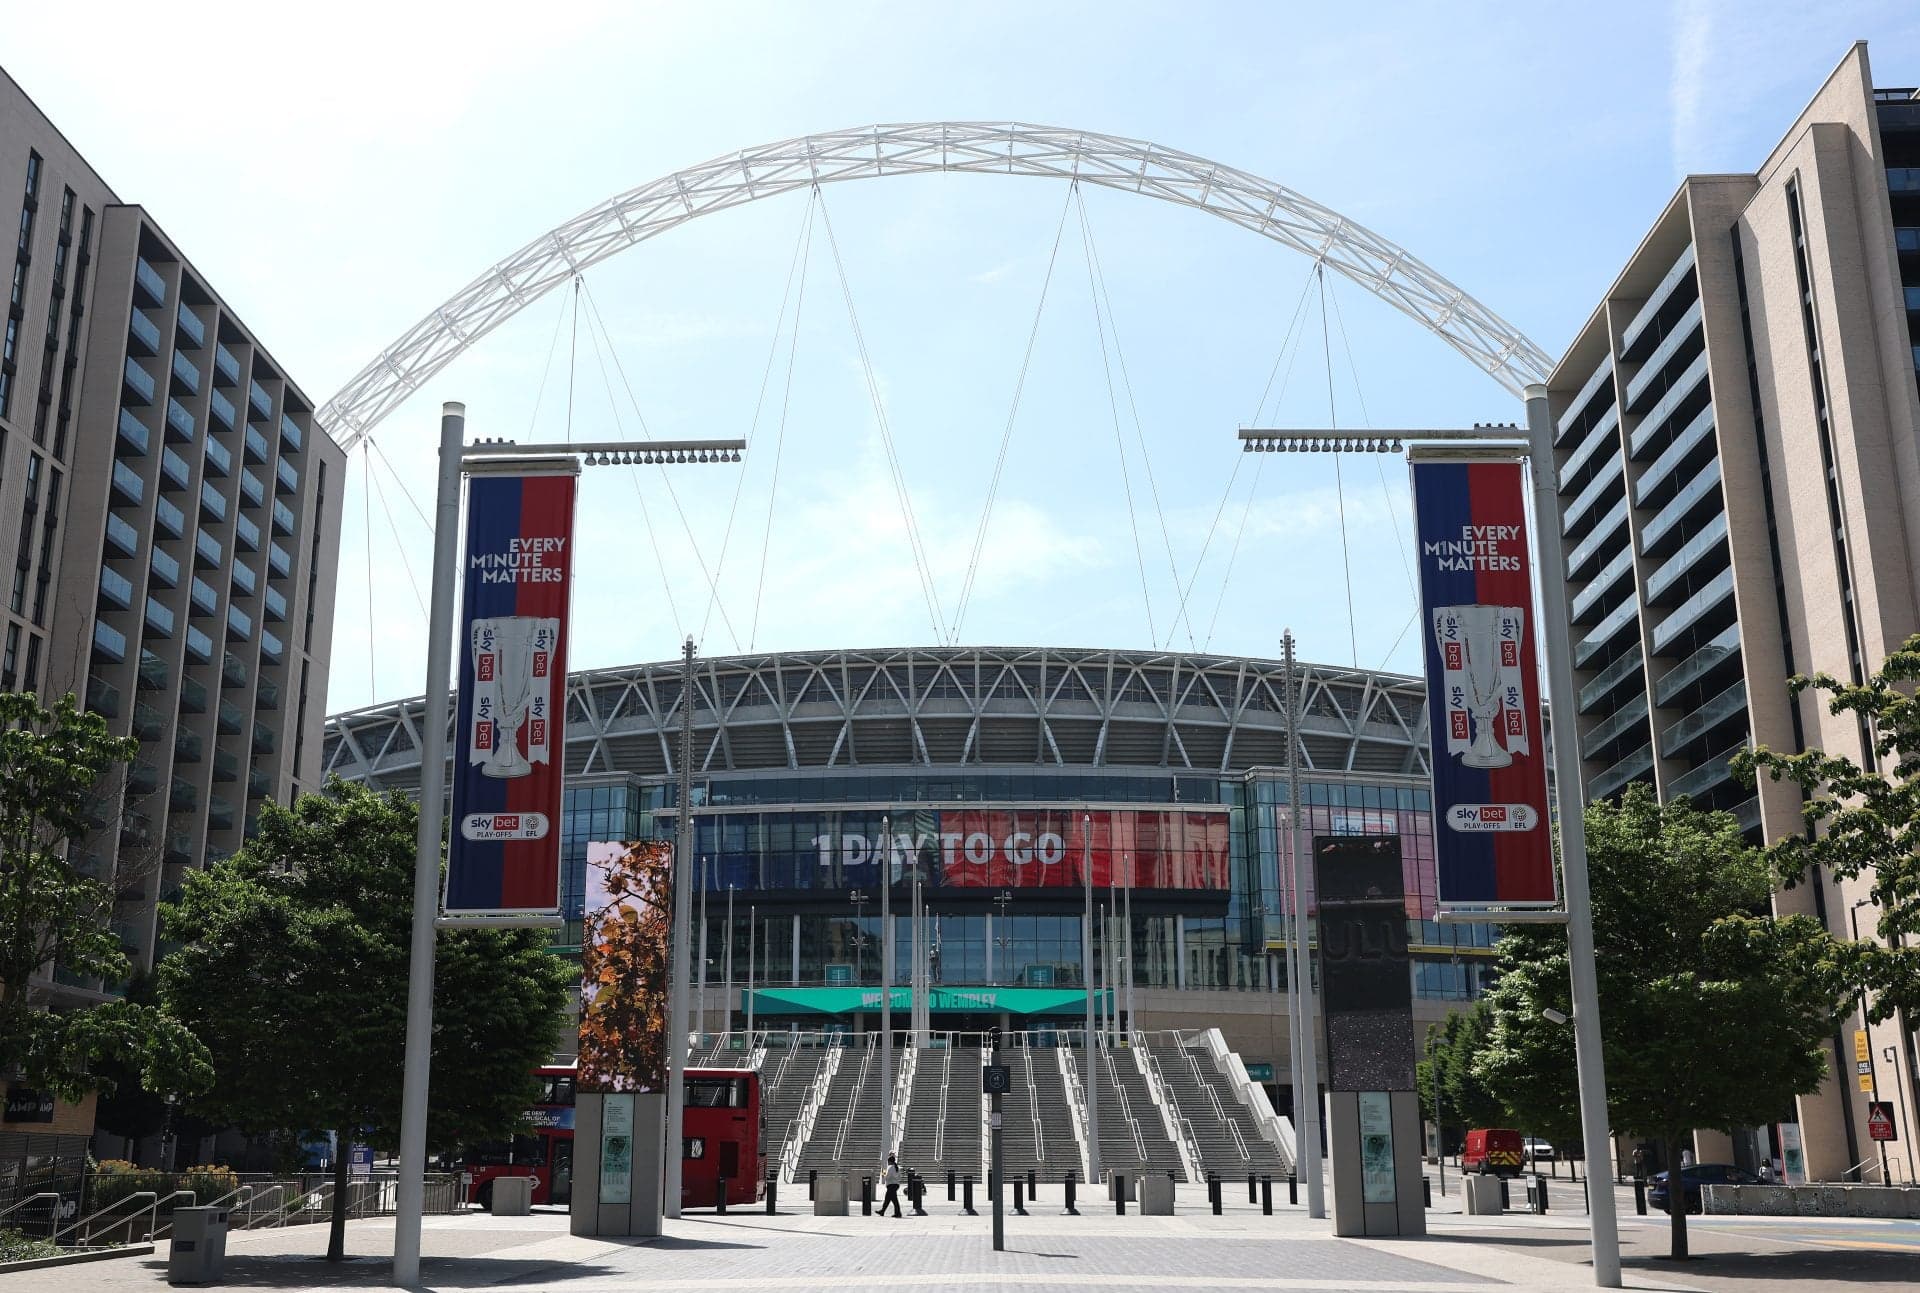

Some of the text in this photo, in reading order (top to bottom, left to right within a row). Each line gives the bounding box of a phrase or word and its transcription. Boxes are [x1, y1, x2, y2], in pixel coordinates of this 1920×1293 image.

[509, 537, 566, 553] EVERY
[1463, 526, 1520, 540] EVERY
[482, 568, 563, 583] MATTERS
[1438, 556, 1520, 571] MATTERS
[480, 629, 494, 680] sky bet
[1445, 617, 1459, 668] sky bet
[1501, 618, 1514, 665] sky bet
[536, 654, 547, 677] bet
[478, 697, 492, 747] sky bet
[532, 697, 545, 744] sky bet
[1451, 686, 1465, 737] sky bet
[1506, 686, 1520, 734] sky bet
[471, 816, 517, 829] sky bet
[1457, 807, 1503, 821] sky bet
[810, 832, 1066, 866] 1 DAY TO GO
[938, 993, 997, 1009] WEMBLEY
